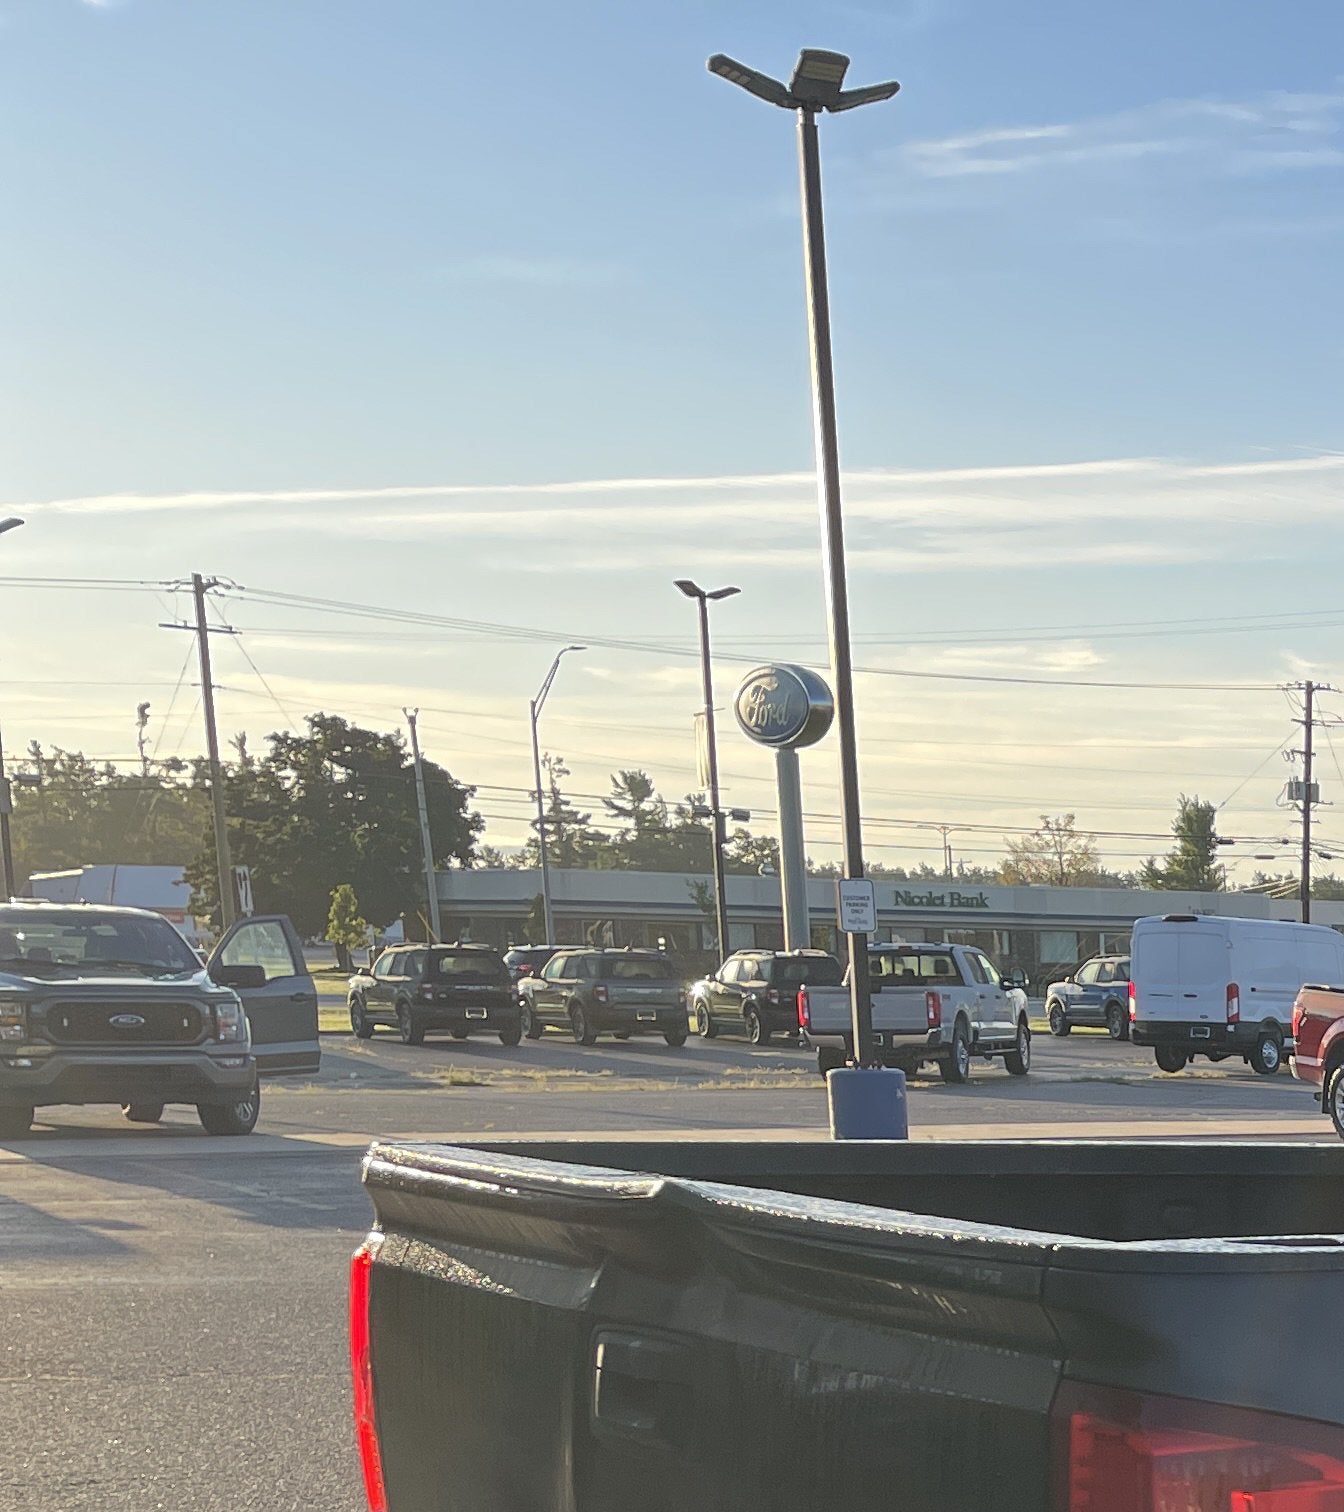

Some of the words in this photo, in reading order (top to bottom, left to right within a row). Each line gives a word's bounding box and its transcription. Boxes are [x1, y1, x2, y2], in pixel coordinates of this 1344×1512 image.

[739, 677, 792, 728] Ford
[893, 889, 946, 907] Nicolet
[948, 891, 990, 908] Bank
